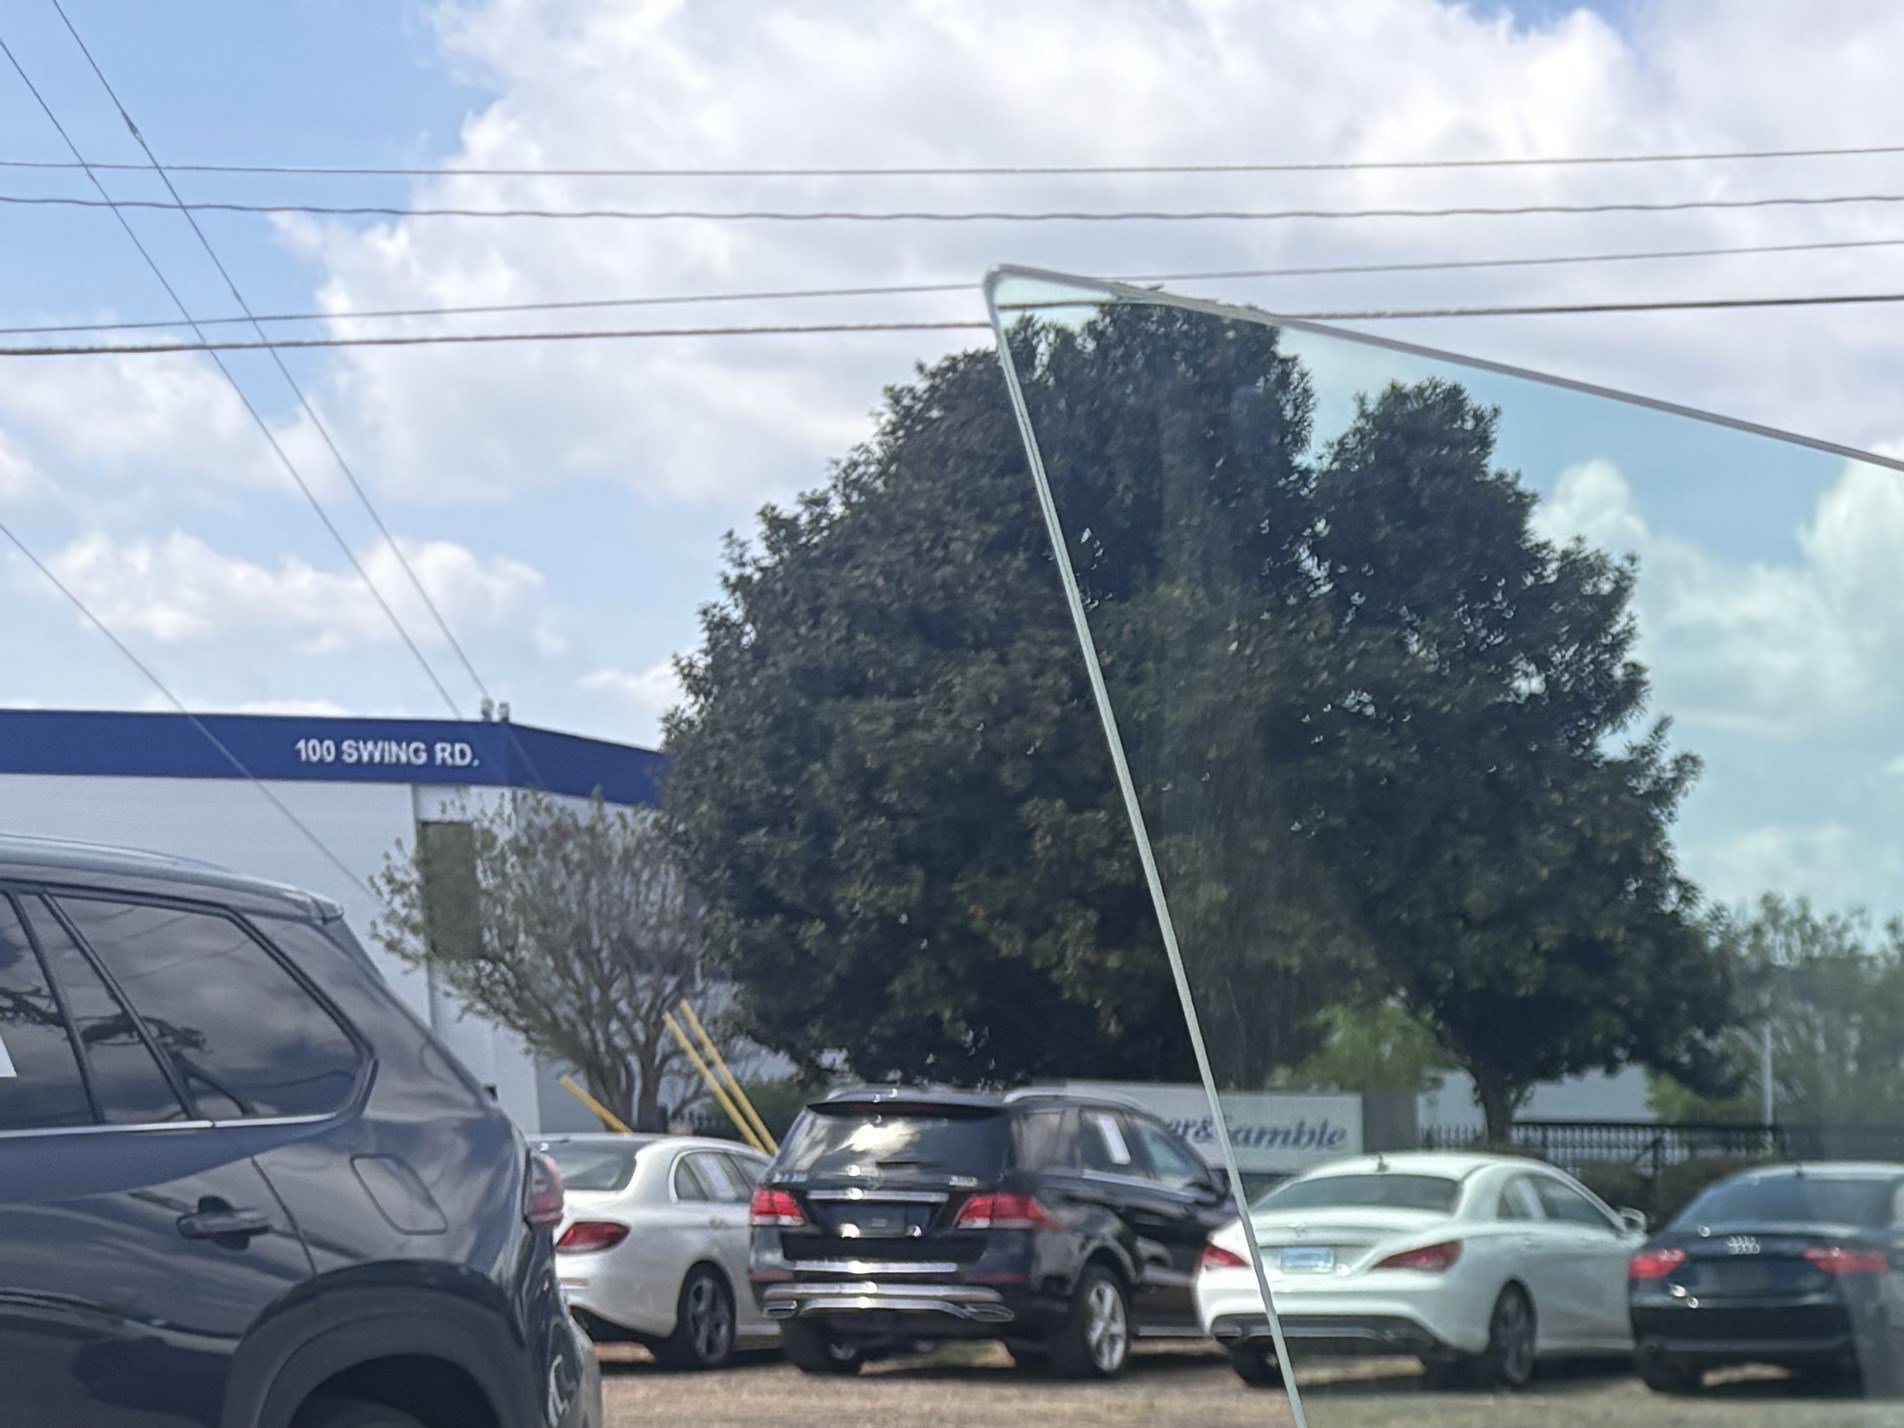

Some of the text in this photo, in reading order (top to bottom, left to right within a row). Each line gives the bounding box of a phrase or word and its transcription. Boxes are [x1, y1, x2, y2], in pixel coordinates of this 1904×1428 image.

[295, 738, 480, 768] 100 SWING RD.
